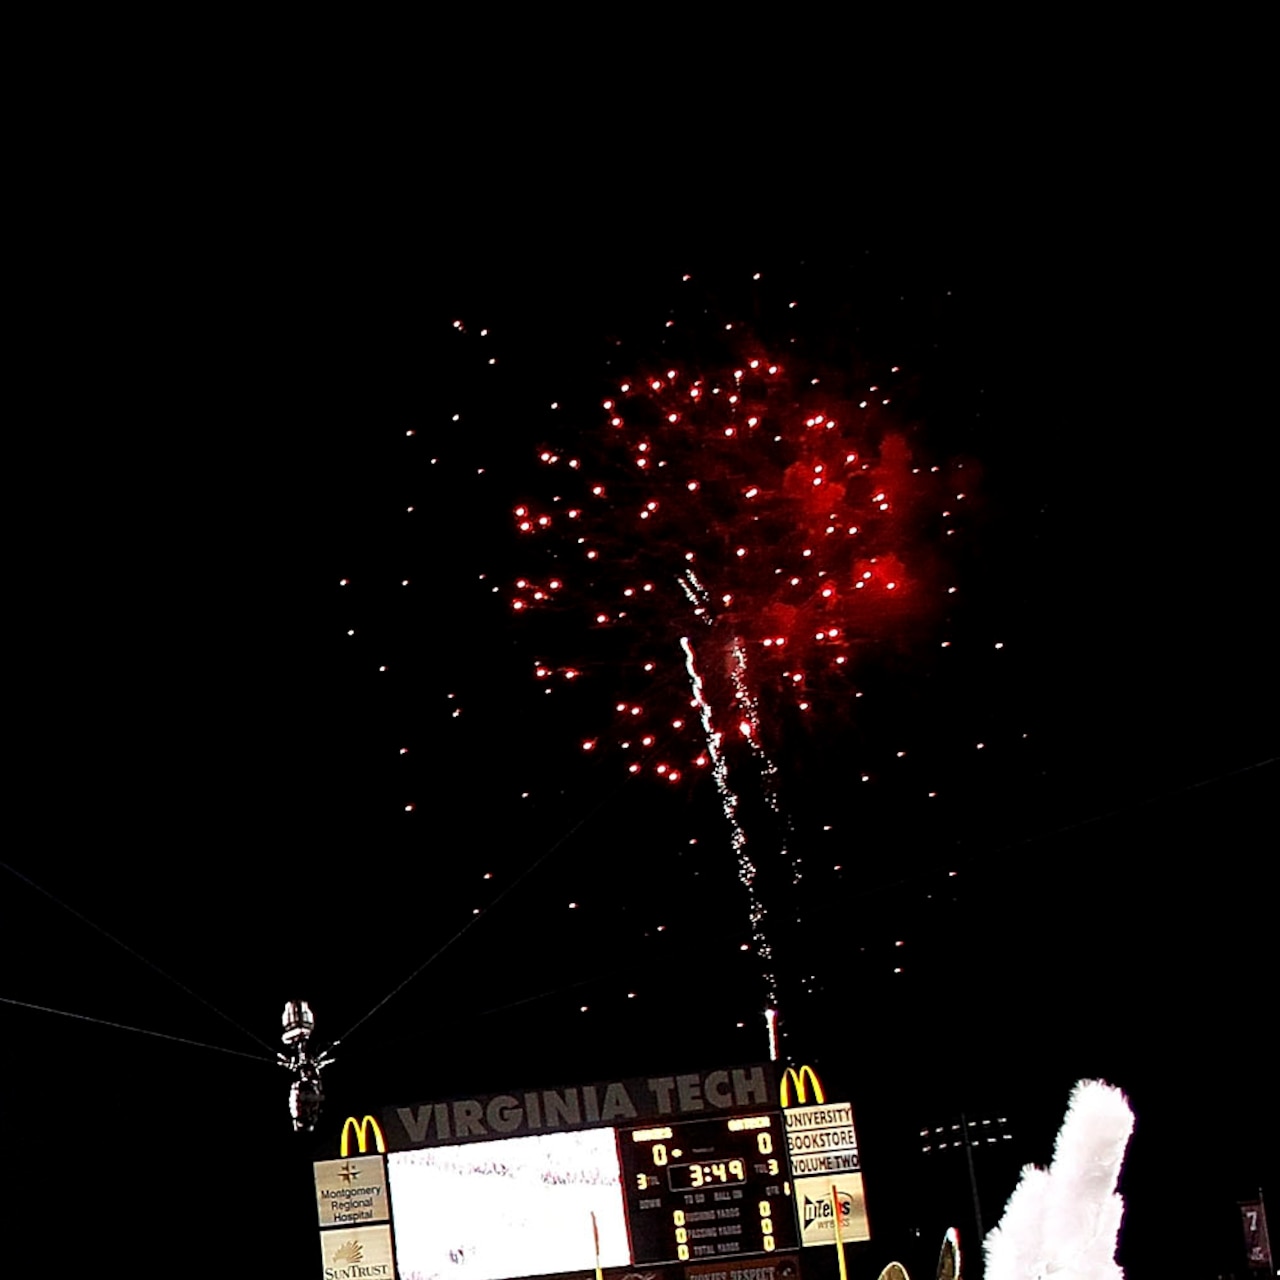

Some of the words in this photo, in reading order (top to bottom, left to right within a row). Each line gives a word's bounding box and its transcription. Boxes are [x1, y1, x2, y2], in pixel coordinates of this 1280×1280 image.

[396, 1082, 638, 1143] VIRGINIA
[648, 1066, 768, 1115] TECH
[785, 1109, 852, 1128] UNIVERSITY
[757, 1132, 773, 1155] 0
[789, 1130, 855, 1151] BOOKSTORE
[652, 1144, 668, 1166] 0
[791, 1156, 833, 1173] VOLUME
[834, 1154, 859, 1170] TWO
[689, 1159, 745, 1187] 3:49
[767, 1159, 779, 1176] 3
[636, 1173, 647, 1190] 3
[321, 1186, 381, 1200] Montgomery
[331, 1198, 373, 1211] Regional
[334, 1209, 373, 1224] Hospital
